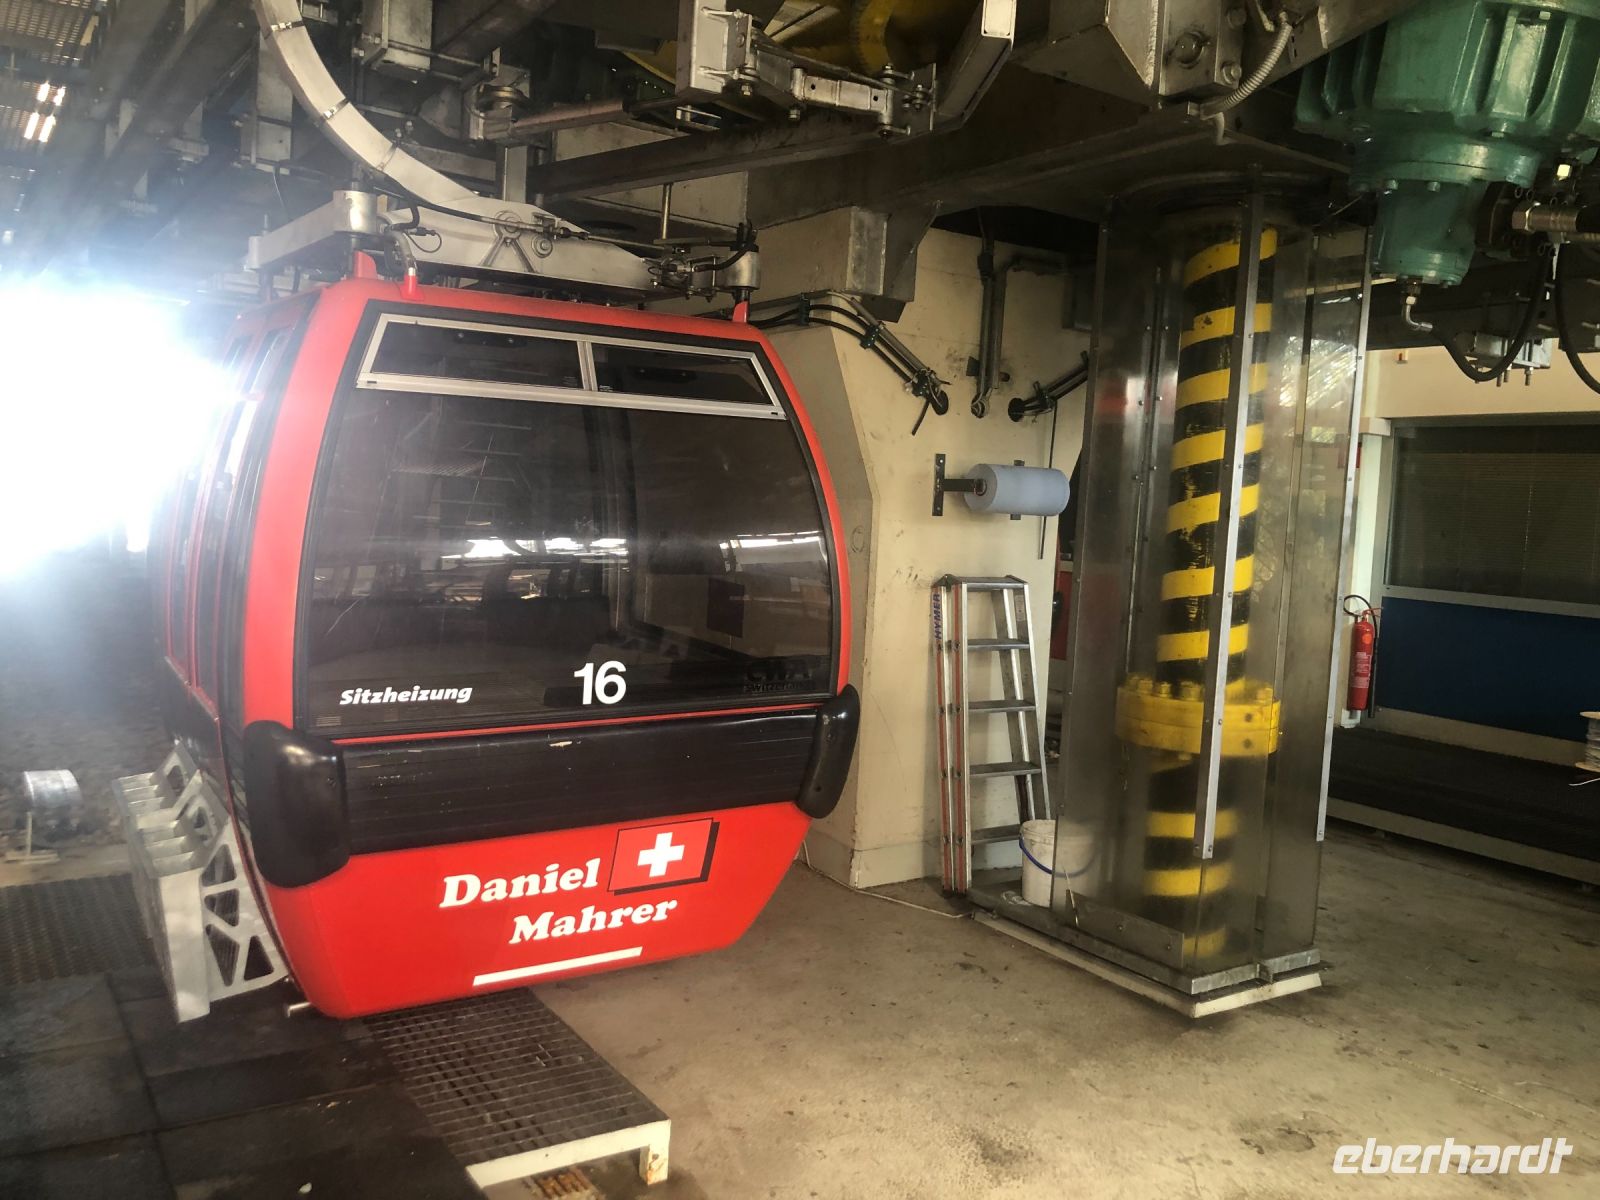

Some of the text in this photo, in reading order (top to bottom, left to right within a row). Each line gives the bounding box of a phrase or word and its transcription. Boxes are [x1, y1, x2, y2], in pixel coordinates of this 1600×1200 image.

[933, 593, 942, 640] HYMER
[339, 685, 473, 705] Sitzheizung
[574, 661, 627, 705] 16
[439, 858, 601, 908] Daniel
[508, 900, 678, 945] Mahrer
